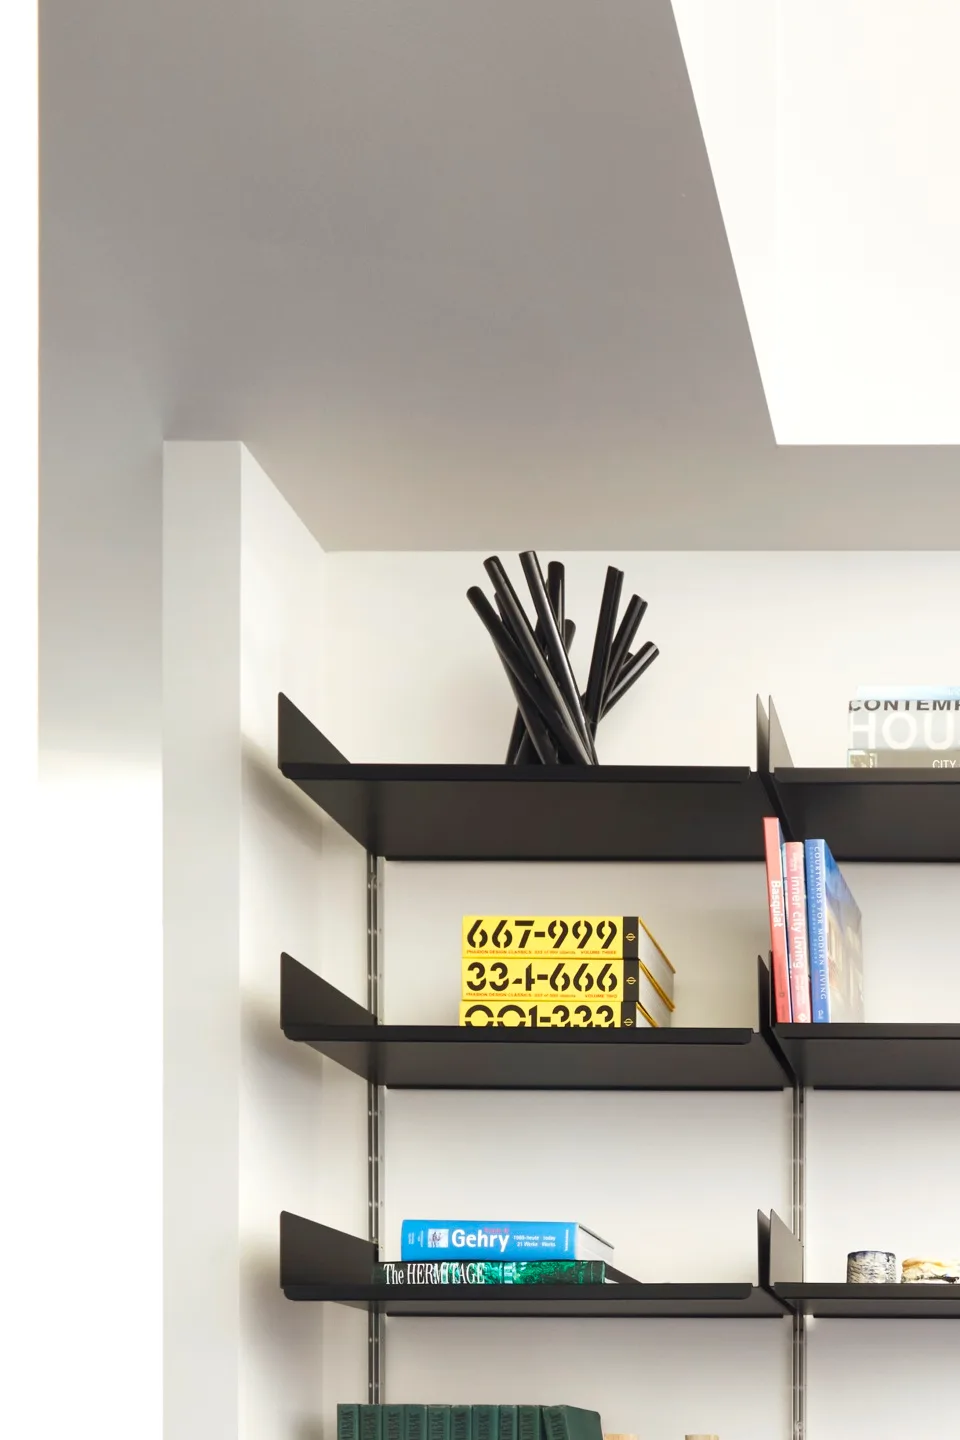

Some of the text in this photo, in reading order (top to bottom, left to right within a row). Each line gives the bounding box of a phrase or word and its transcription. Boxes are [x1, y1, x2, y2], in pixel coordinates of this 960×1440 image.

[932, 759, 957, 768] CITY
[814, 846, 823, 904] COURTYARDS
[770, 880, 784, 928] Basquiat
[466, 919, 618, 950] 667-999
[791, 912, 803, 934] city
[793, 935, 806, 969] living
[816, 928, 825, 966] MODERN
[466, 961, 618, 992] 334-666
[819, 965, 828, 1001] LIVING
[451, 1229, 510, 1252] Gehry
[383, 1262, 485, 1285] The HERMITAGE
